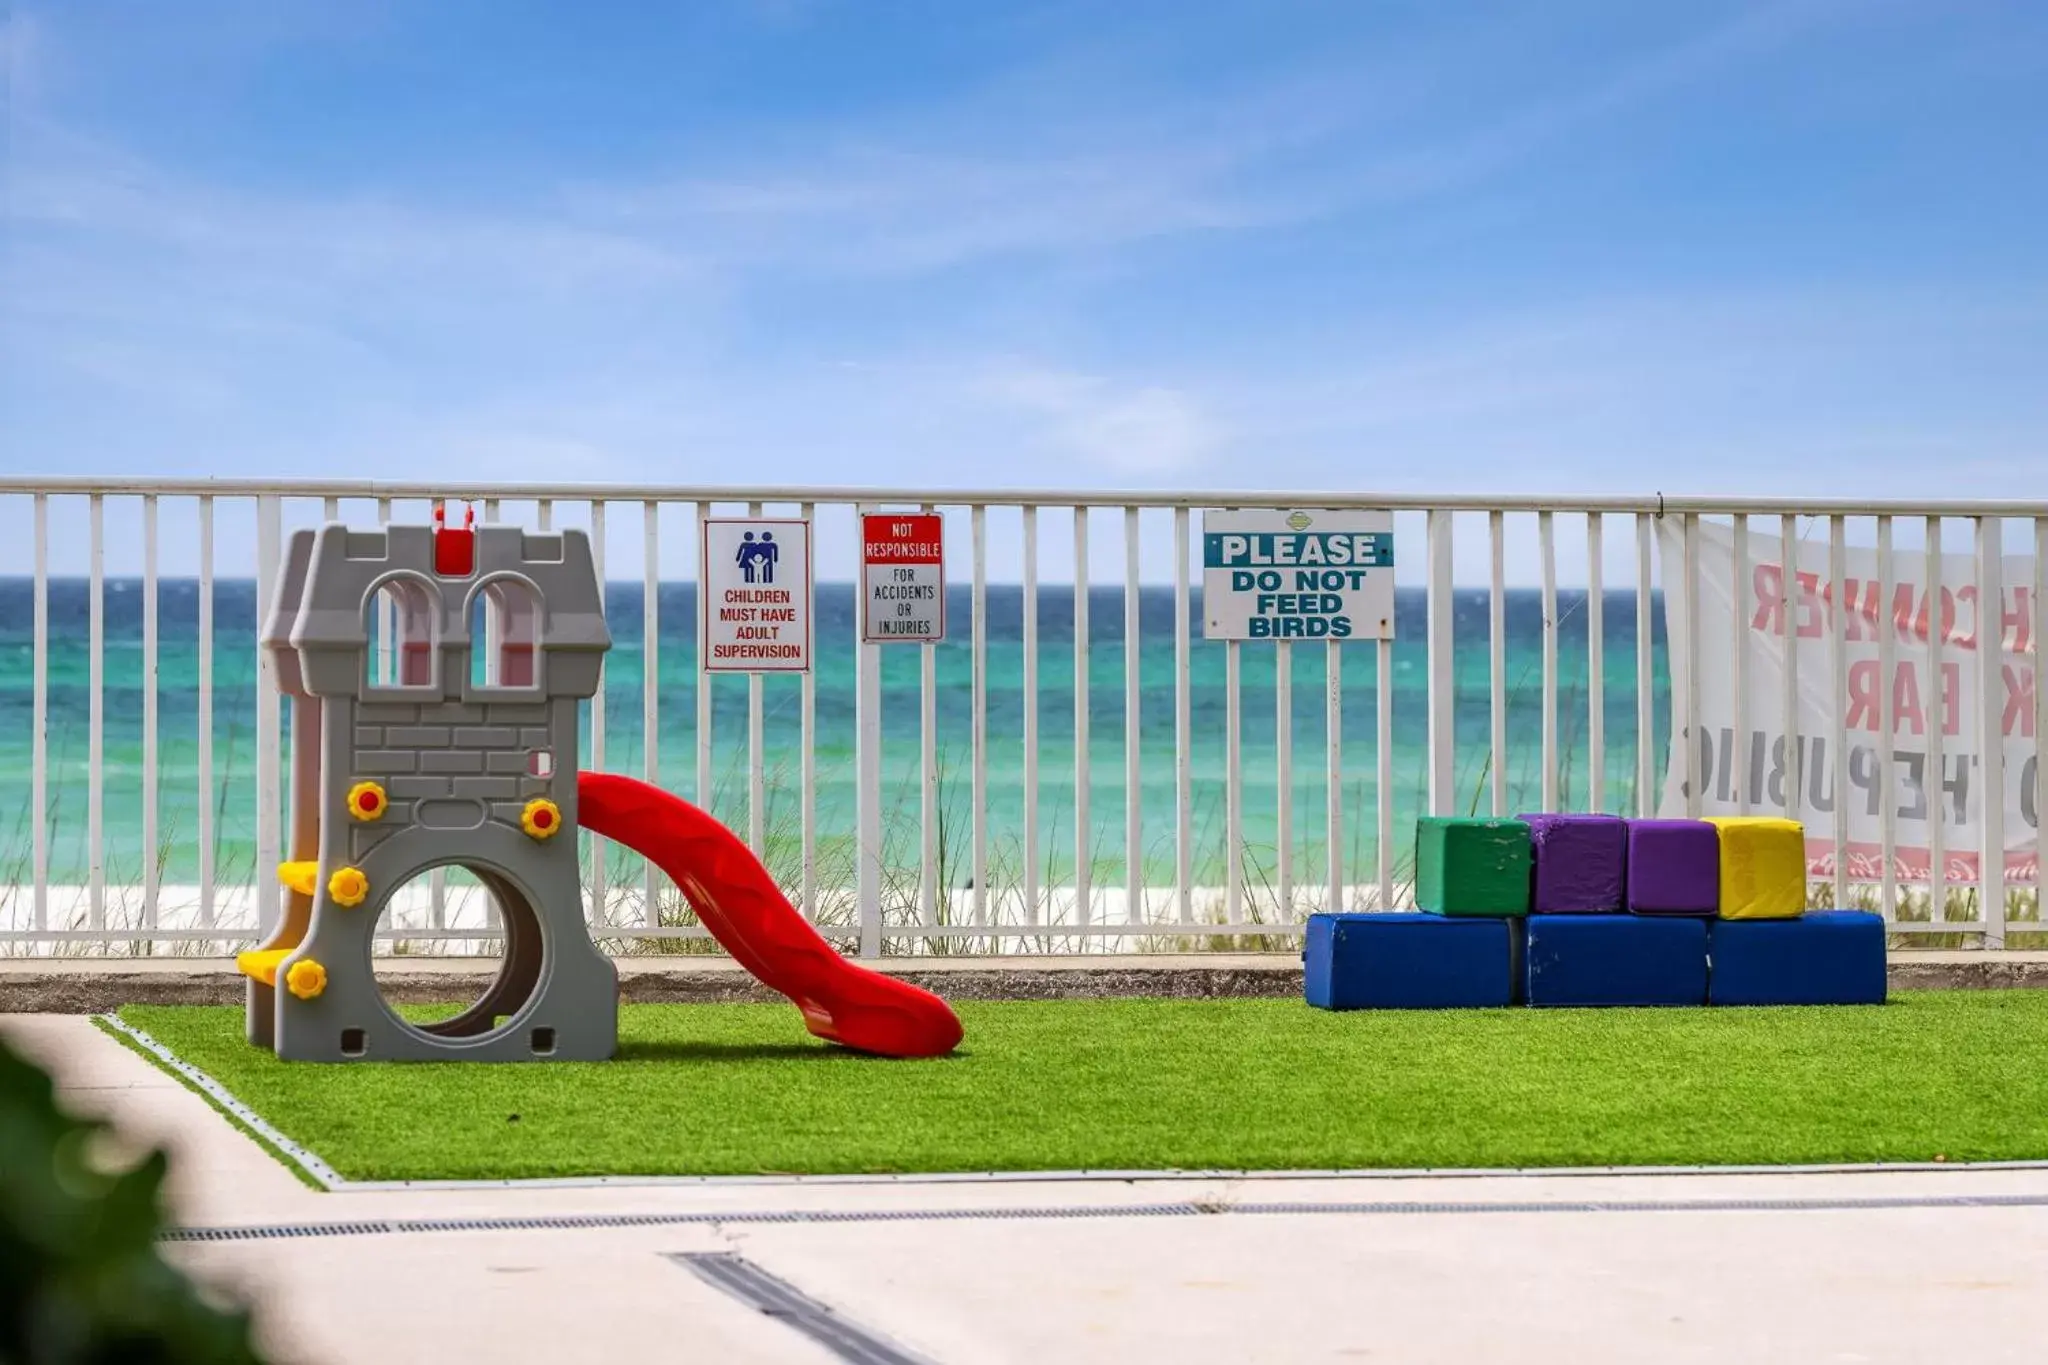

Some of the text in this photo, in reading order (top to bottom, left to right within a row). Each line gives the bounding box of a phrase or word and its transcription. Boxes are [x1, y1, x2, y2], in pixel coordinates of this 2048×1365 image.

[892, 523, 913, 537] NOT
[866, 543, 940, 557] RESPONSIBLE
[1222, 535, 1376, 565] PLEASE
[893, 568, 914, 582] FOR
[1232, 570, 1366, 592] DO NOT
[724, 590, 790, 603] CHILDREN
[874, 586, 934, 600] ACCIDENTS
[897, 603, 912, 617] OR
[1257, 594, 1343, 614] FEED
[720, 608, 796, 622] MUST HAVE
[736, 627, 779, 640] ADULT
[879, 620, 931, 634] INJURIES
[1249, 616, 1352, 638] BIRDS
[714, 645, 801, 658] SUPERVISION
